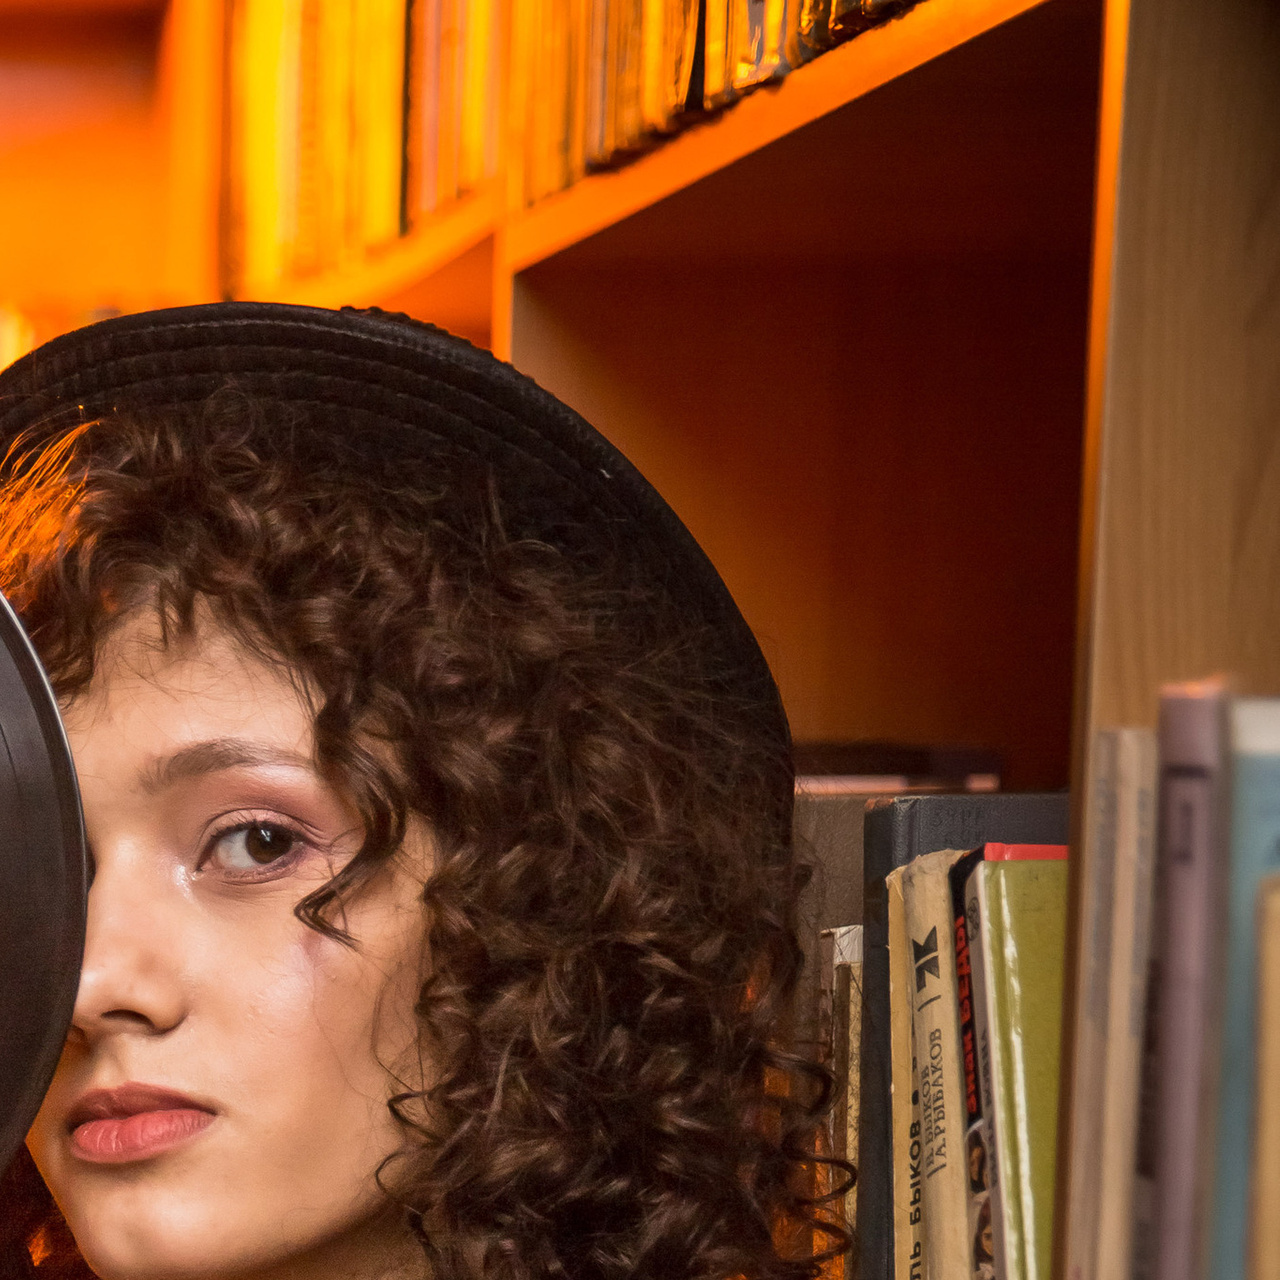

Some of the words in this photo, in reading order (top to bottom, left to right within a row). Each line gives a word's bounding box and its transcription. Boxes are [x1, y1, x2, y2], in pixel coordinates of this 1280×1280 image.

[954, 915, 971, 1025] БЕДЫ
[921, 1064, 934, 1146] БЫКОВ
[909, 1119, 922, 1226] БЫКОВ
